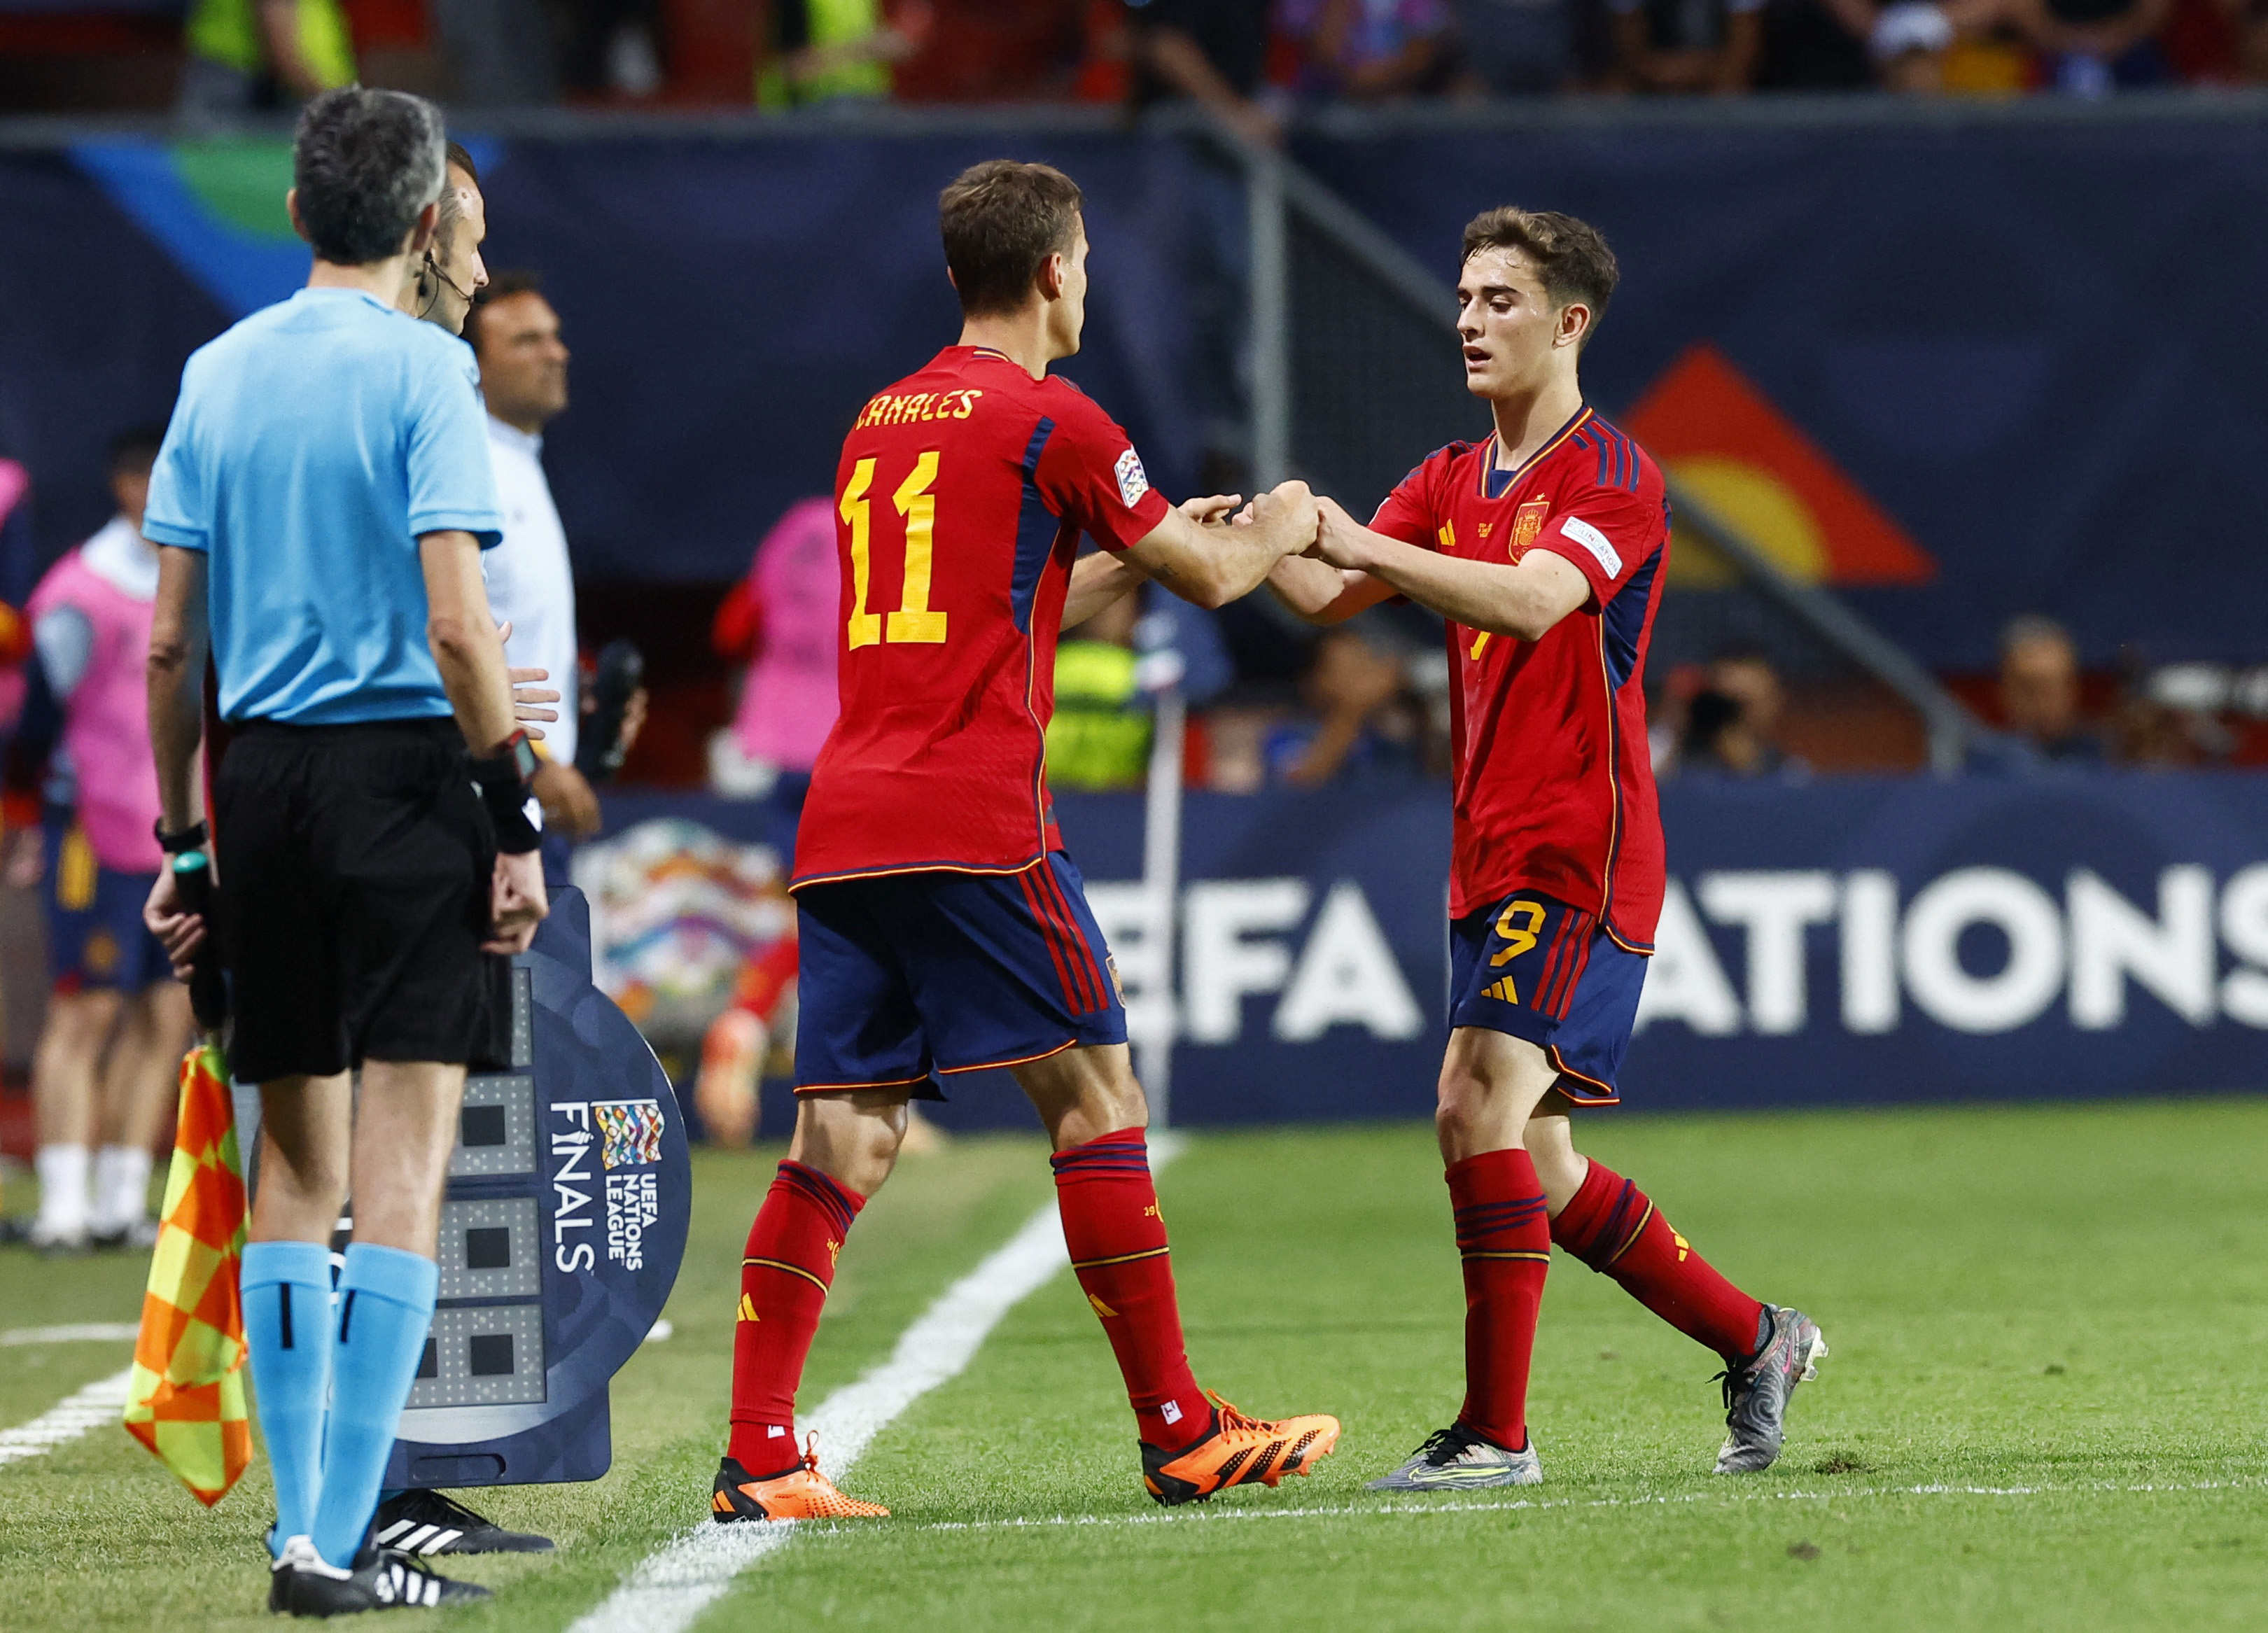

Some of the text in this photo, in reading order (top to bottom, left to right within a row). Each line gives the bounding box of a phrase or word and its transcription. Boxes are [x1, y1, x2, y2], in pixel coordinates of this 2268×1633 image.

[855, 389, 983, 430] CANALES
[839, 451, 947, 652] 11
[1565, 522, 1619, 573] FOUNDATION
[1083, 862, 2268, 1043] EFA ATION
[1489, 900, 1547, 967] 9
[550, 1101, 595, 1273] FINALS
[606, 1175, 625, 1260] LEAGUE
[623, 1174, 643, 1271] NATIONS
[640, 1173, 658, 1228] UEFA
